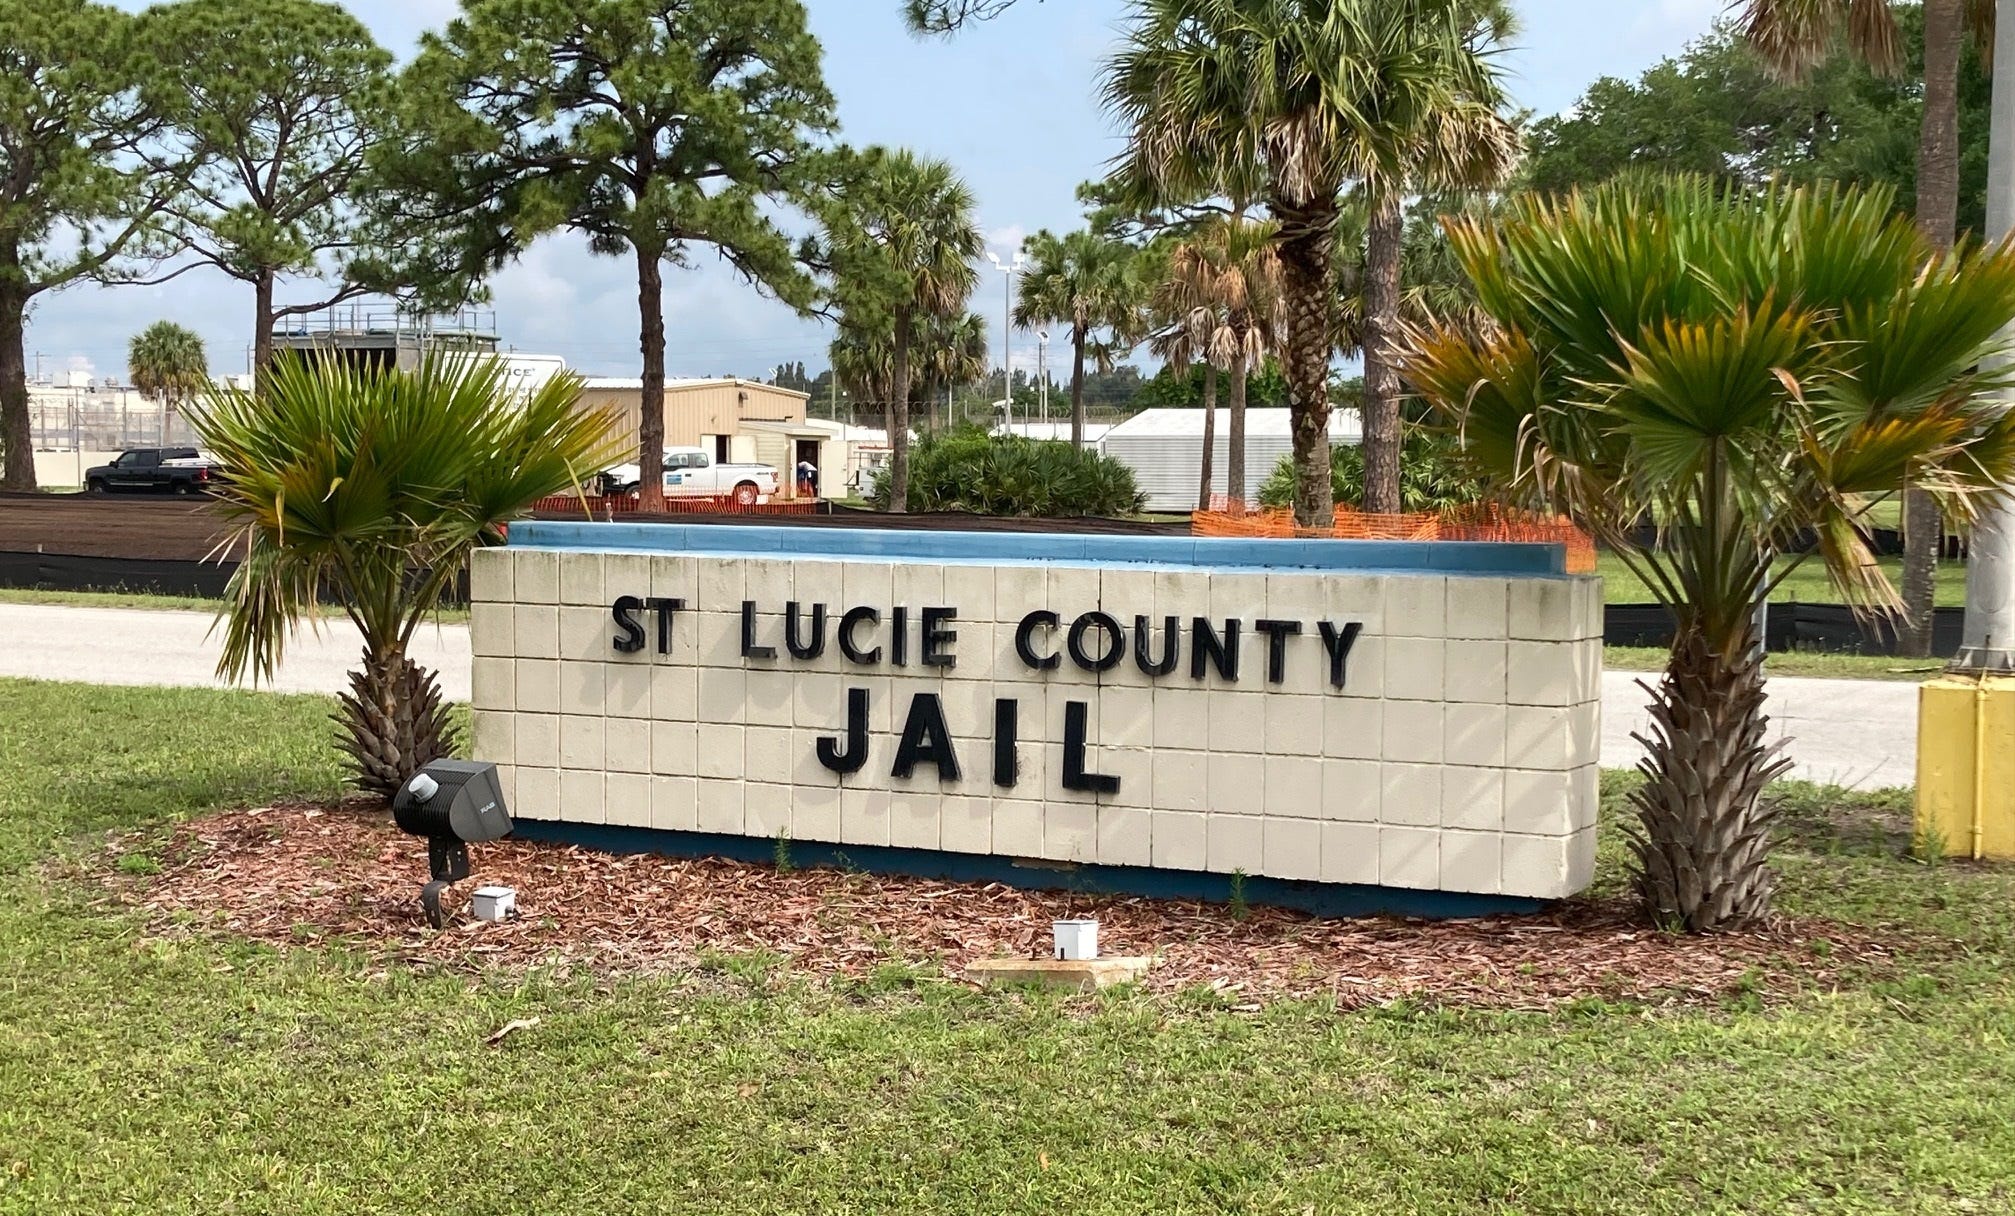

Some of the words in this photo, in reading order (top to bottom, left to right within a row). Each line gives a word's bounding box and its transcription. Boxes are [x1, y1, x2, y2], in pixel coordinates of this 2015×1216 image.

[612, 594, 687, 656] ST
[741, 600, 957, 668] LUCIE
[1015, 609, 1363, 691] COUNTY
[816, 687, 1121, 794] JAIL
